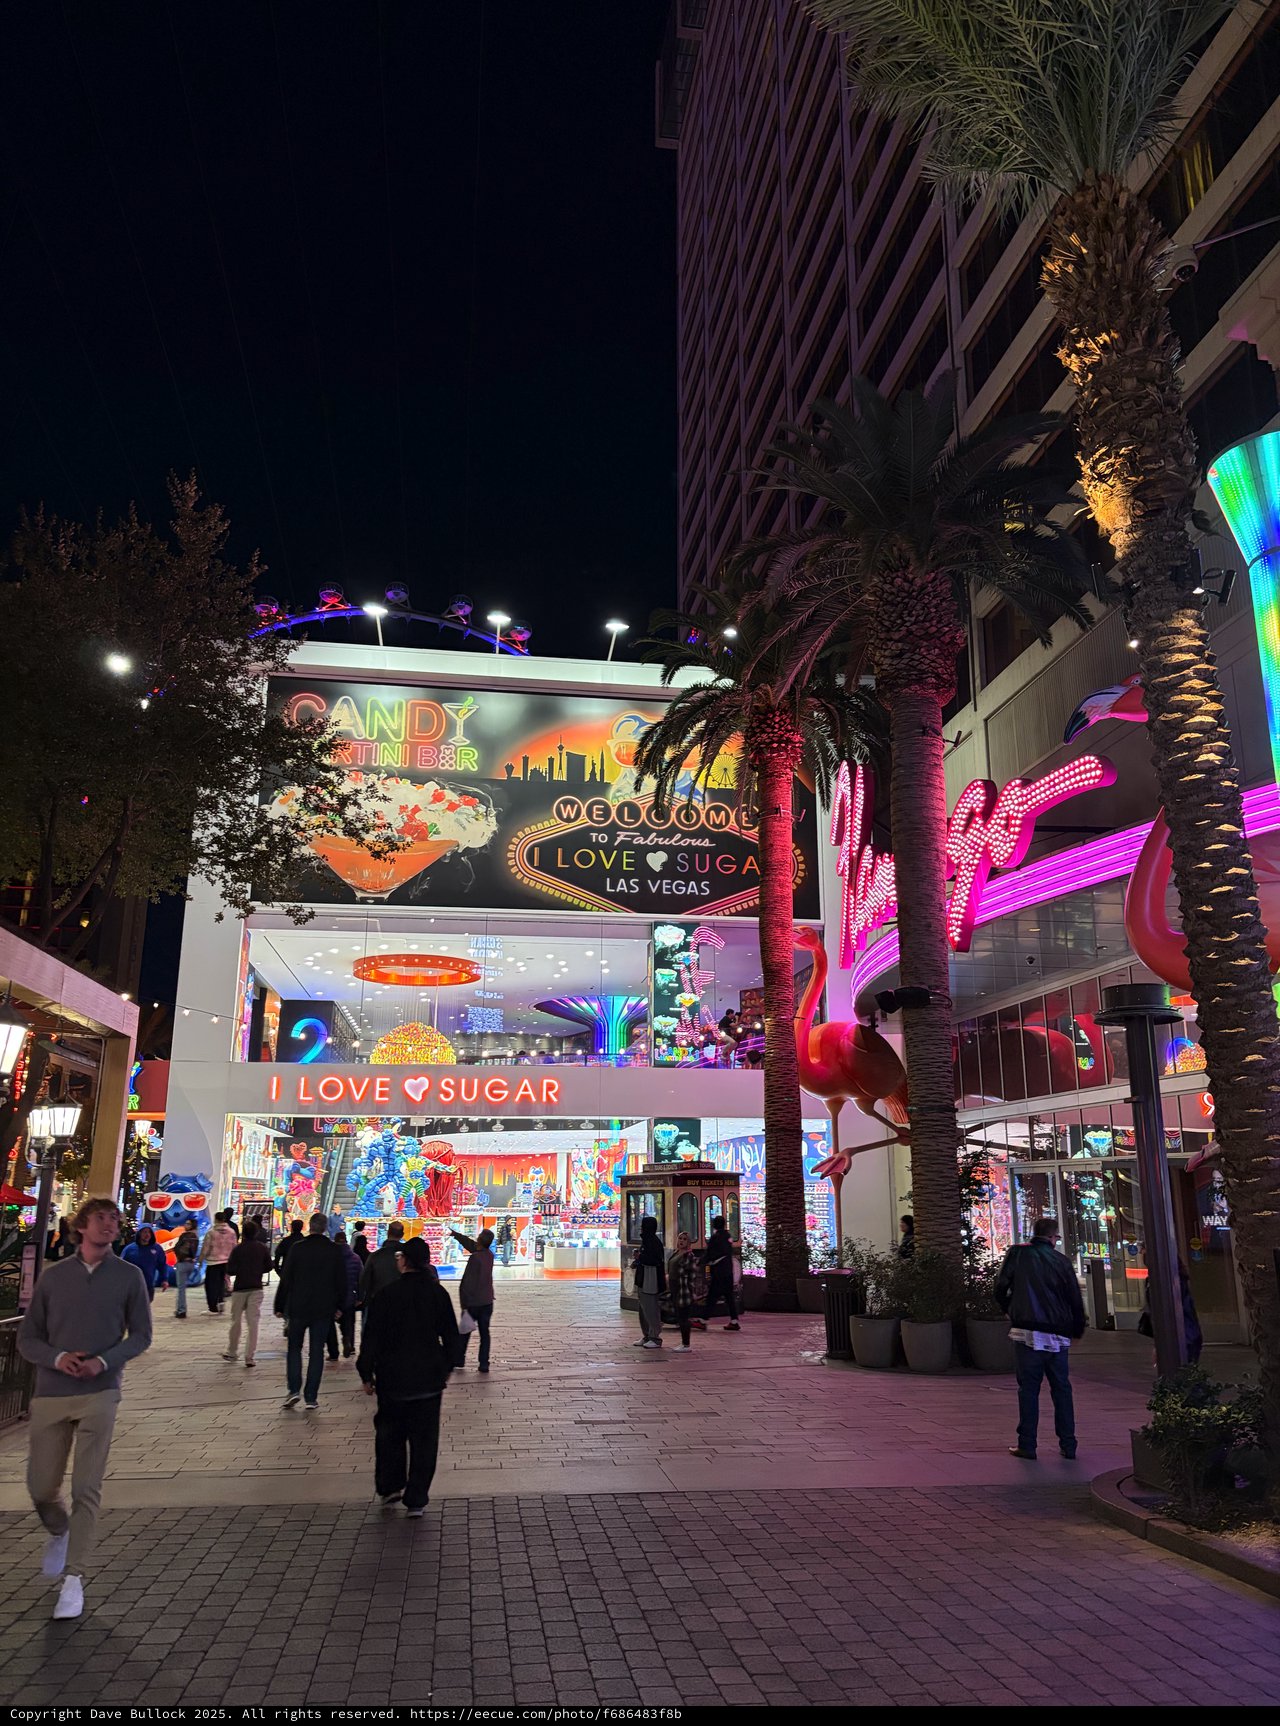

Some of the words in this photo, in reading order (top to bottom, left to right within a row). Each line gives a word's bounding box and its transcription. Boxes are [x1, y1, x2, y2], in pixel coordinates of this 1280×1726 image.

[590, 832, 609, 843] TO
[613, 831, 716, 848] Fabulous
[533, 846, 540, 867] I
[557, 848, 636, 871] LOVE
[676, 852, 761, 875] SUGA
[606, 877, 640, 893] LAS
[647, 879, 710, 896] VEGAS
[271, 1076, 279, 1101] I
[299, 1076, 391, 1101] LOVE
[438, 1076, 560, 1103] SUGAR
